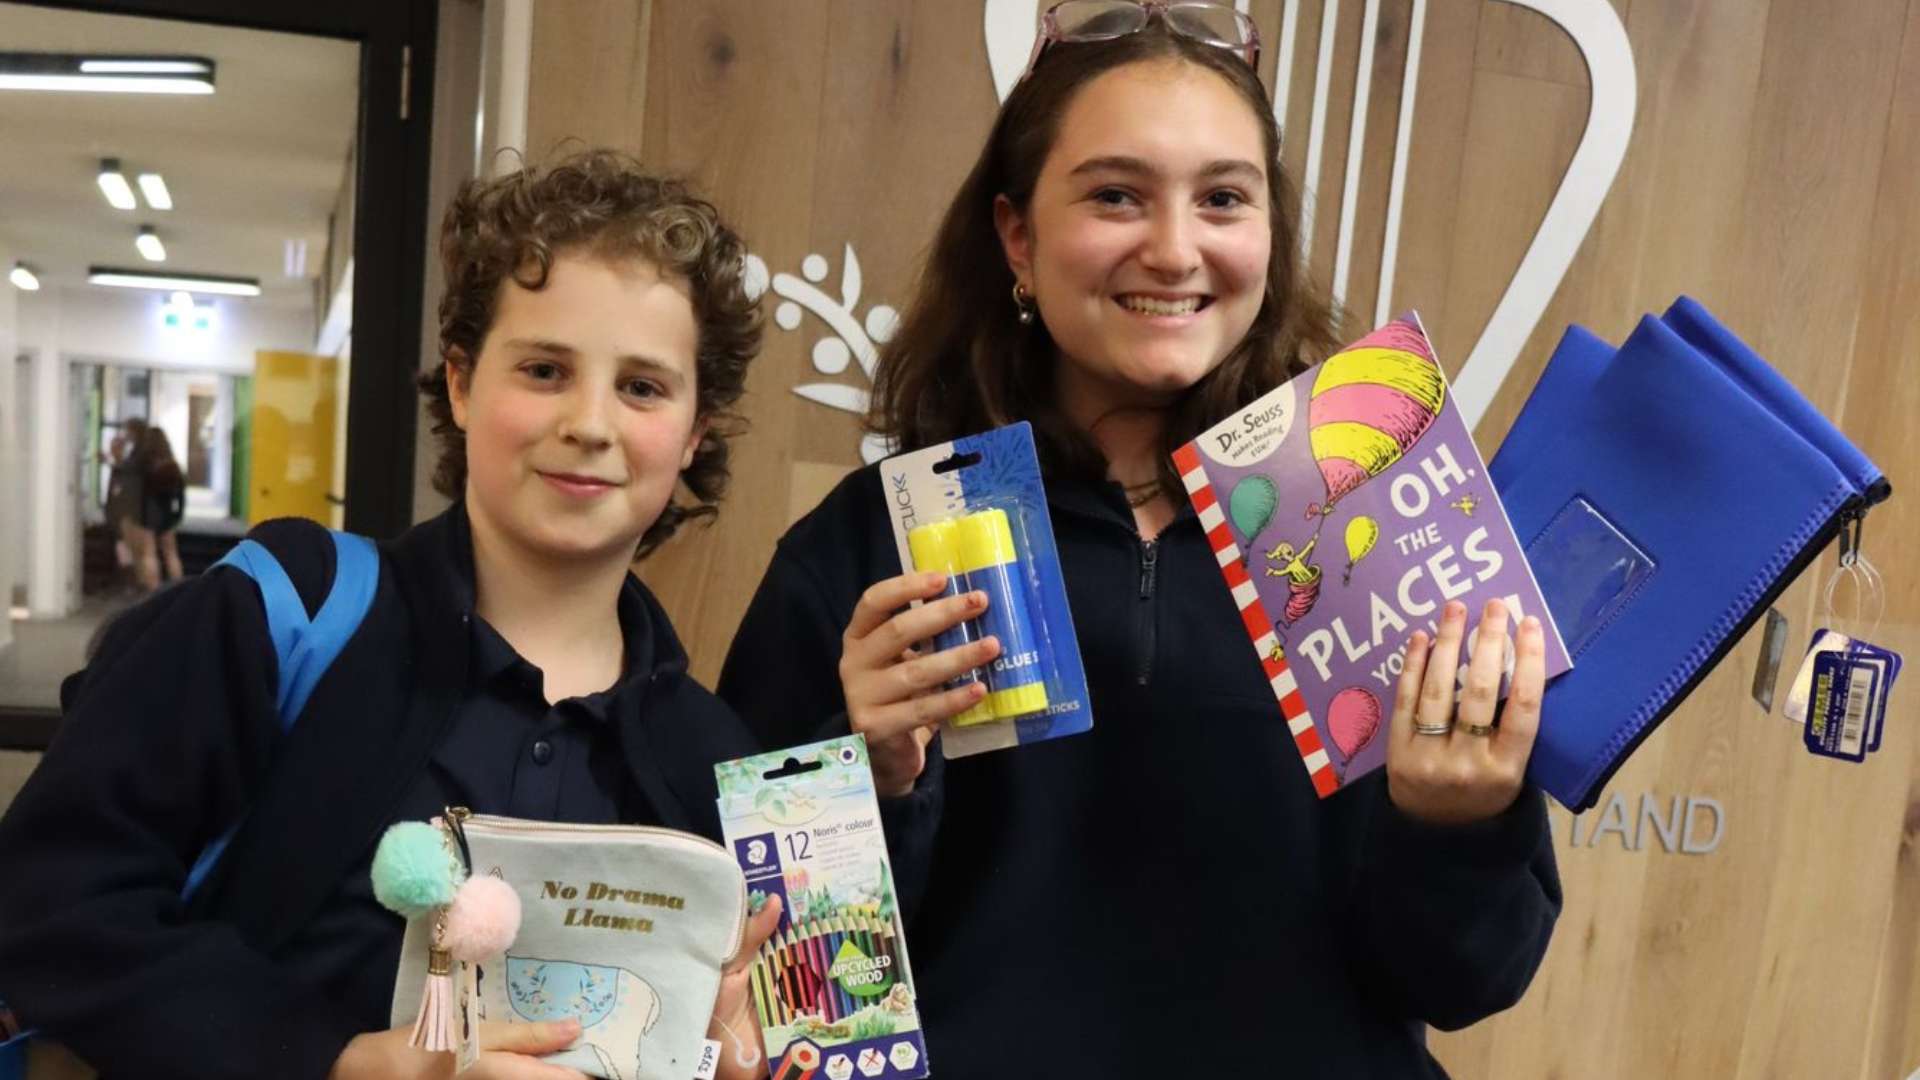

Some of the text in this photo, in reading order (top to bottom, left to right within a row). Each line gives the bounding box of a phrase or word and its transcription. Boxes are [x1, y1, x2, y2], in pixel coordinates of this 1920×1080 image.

[1216, 404, 1284, 453] Dr. Seuss
[1394, 522, 1443, 556] THE
[1297, 526, 1504, 682] PLACES
[784, 830, 814, 862] 12
[844, 818, 875, 831] colour
[540, 880, 685, 911] No Drama
[564, 907, 654, 933] Llama
[832, 954, 891, 977] UPCYCLED
[846, 969, 884, 987] WOOD
